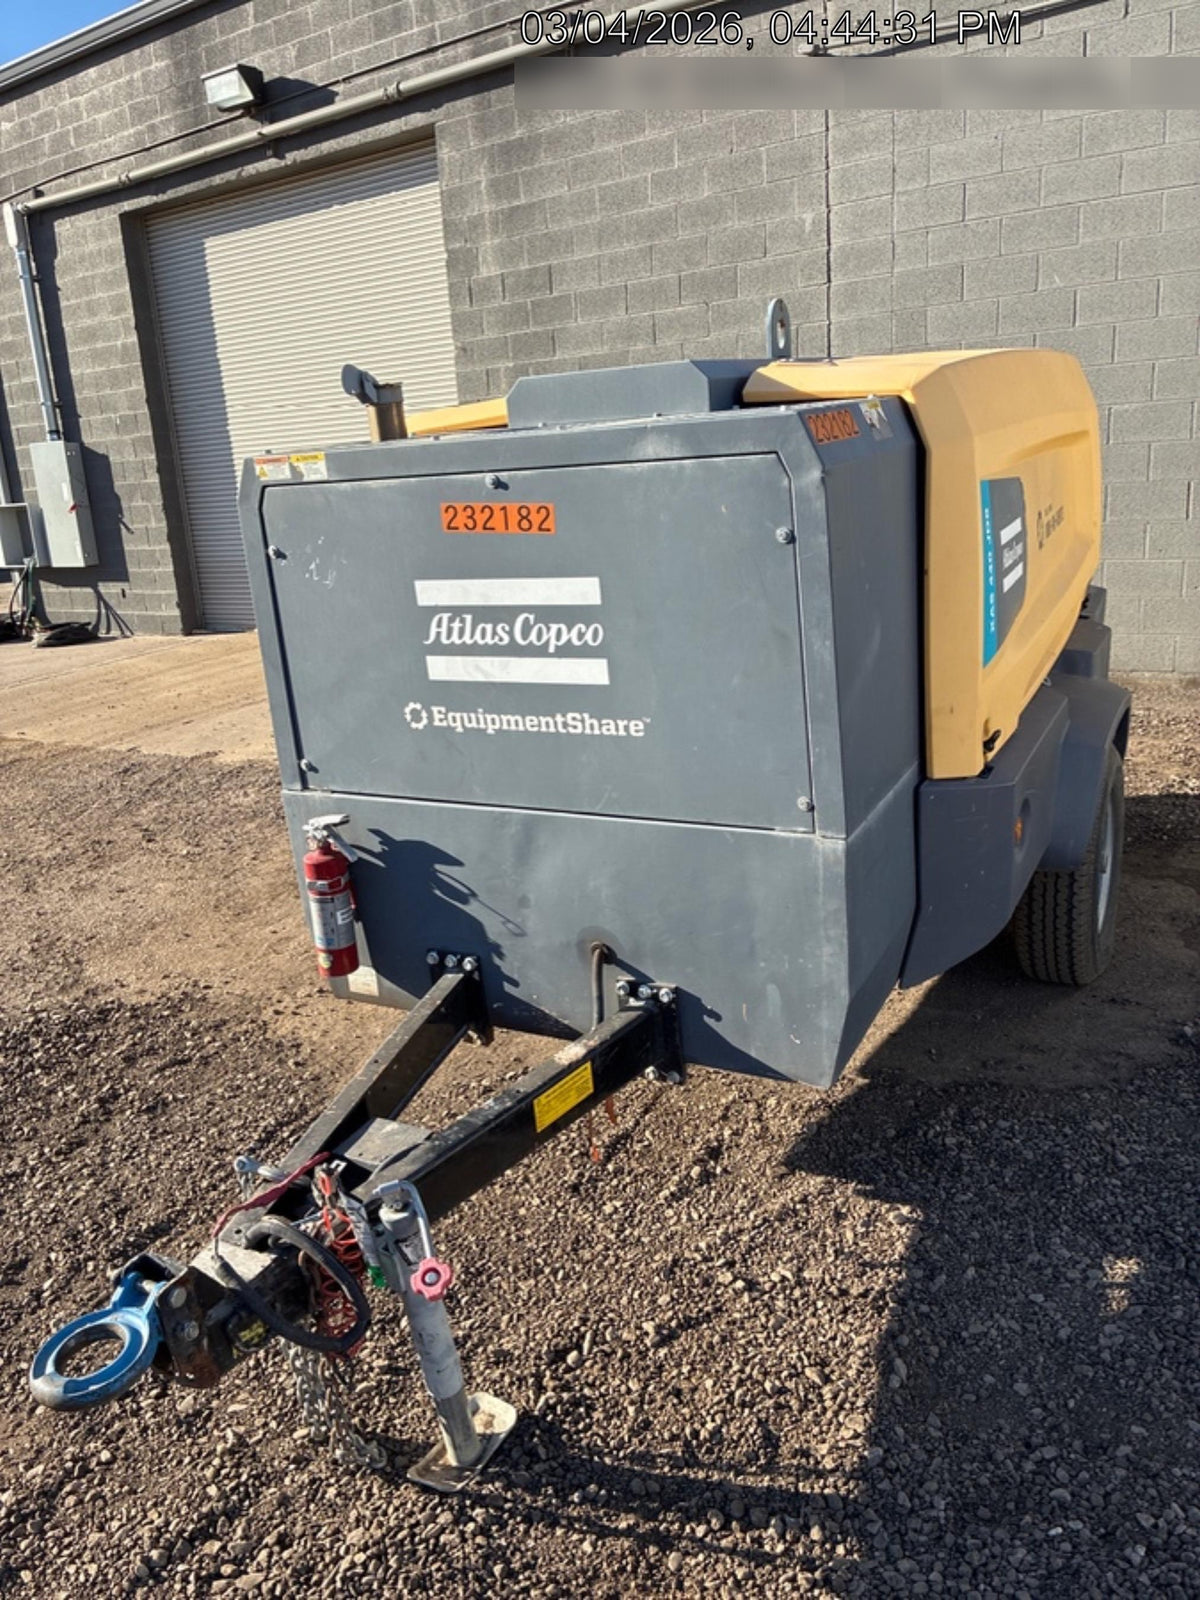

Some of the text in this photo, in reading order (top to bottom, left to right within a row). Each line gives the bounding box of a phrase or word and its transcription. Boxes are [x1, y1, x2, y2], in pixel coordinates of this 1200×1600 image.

[443, 504, 553, 533] 232182
[422, 612, 604, 653] Atlas Copco
